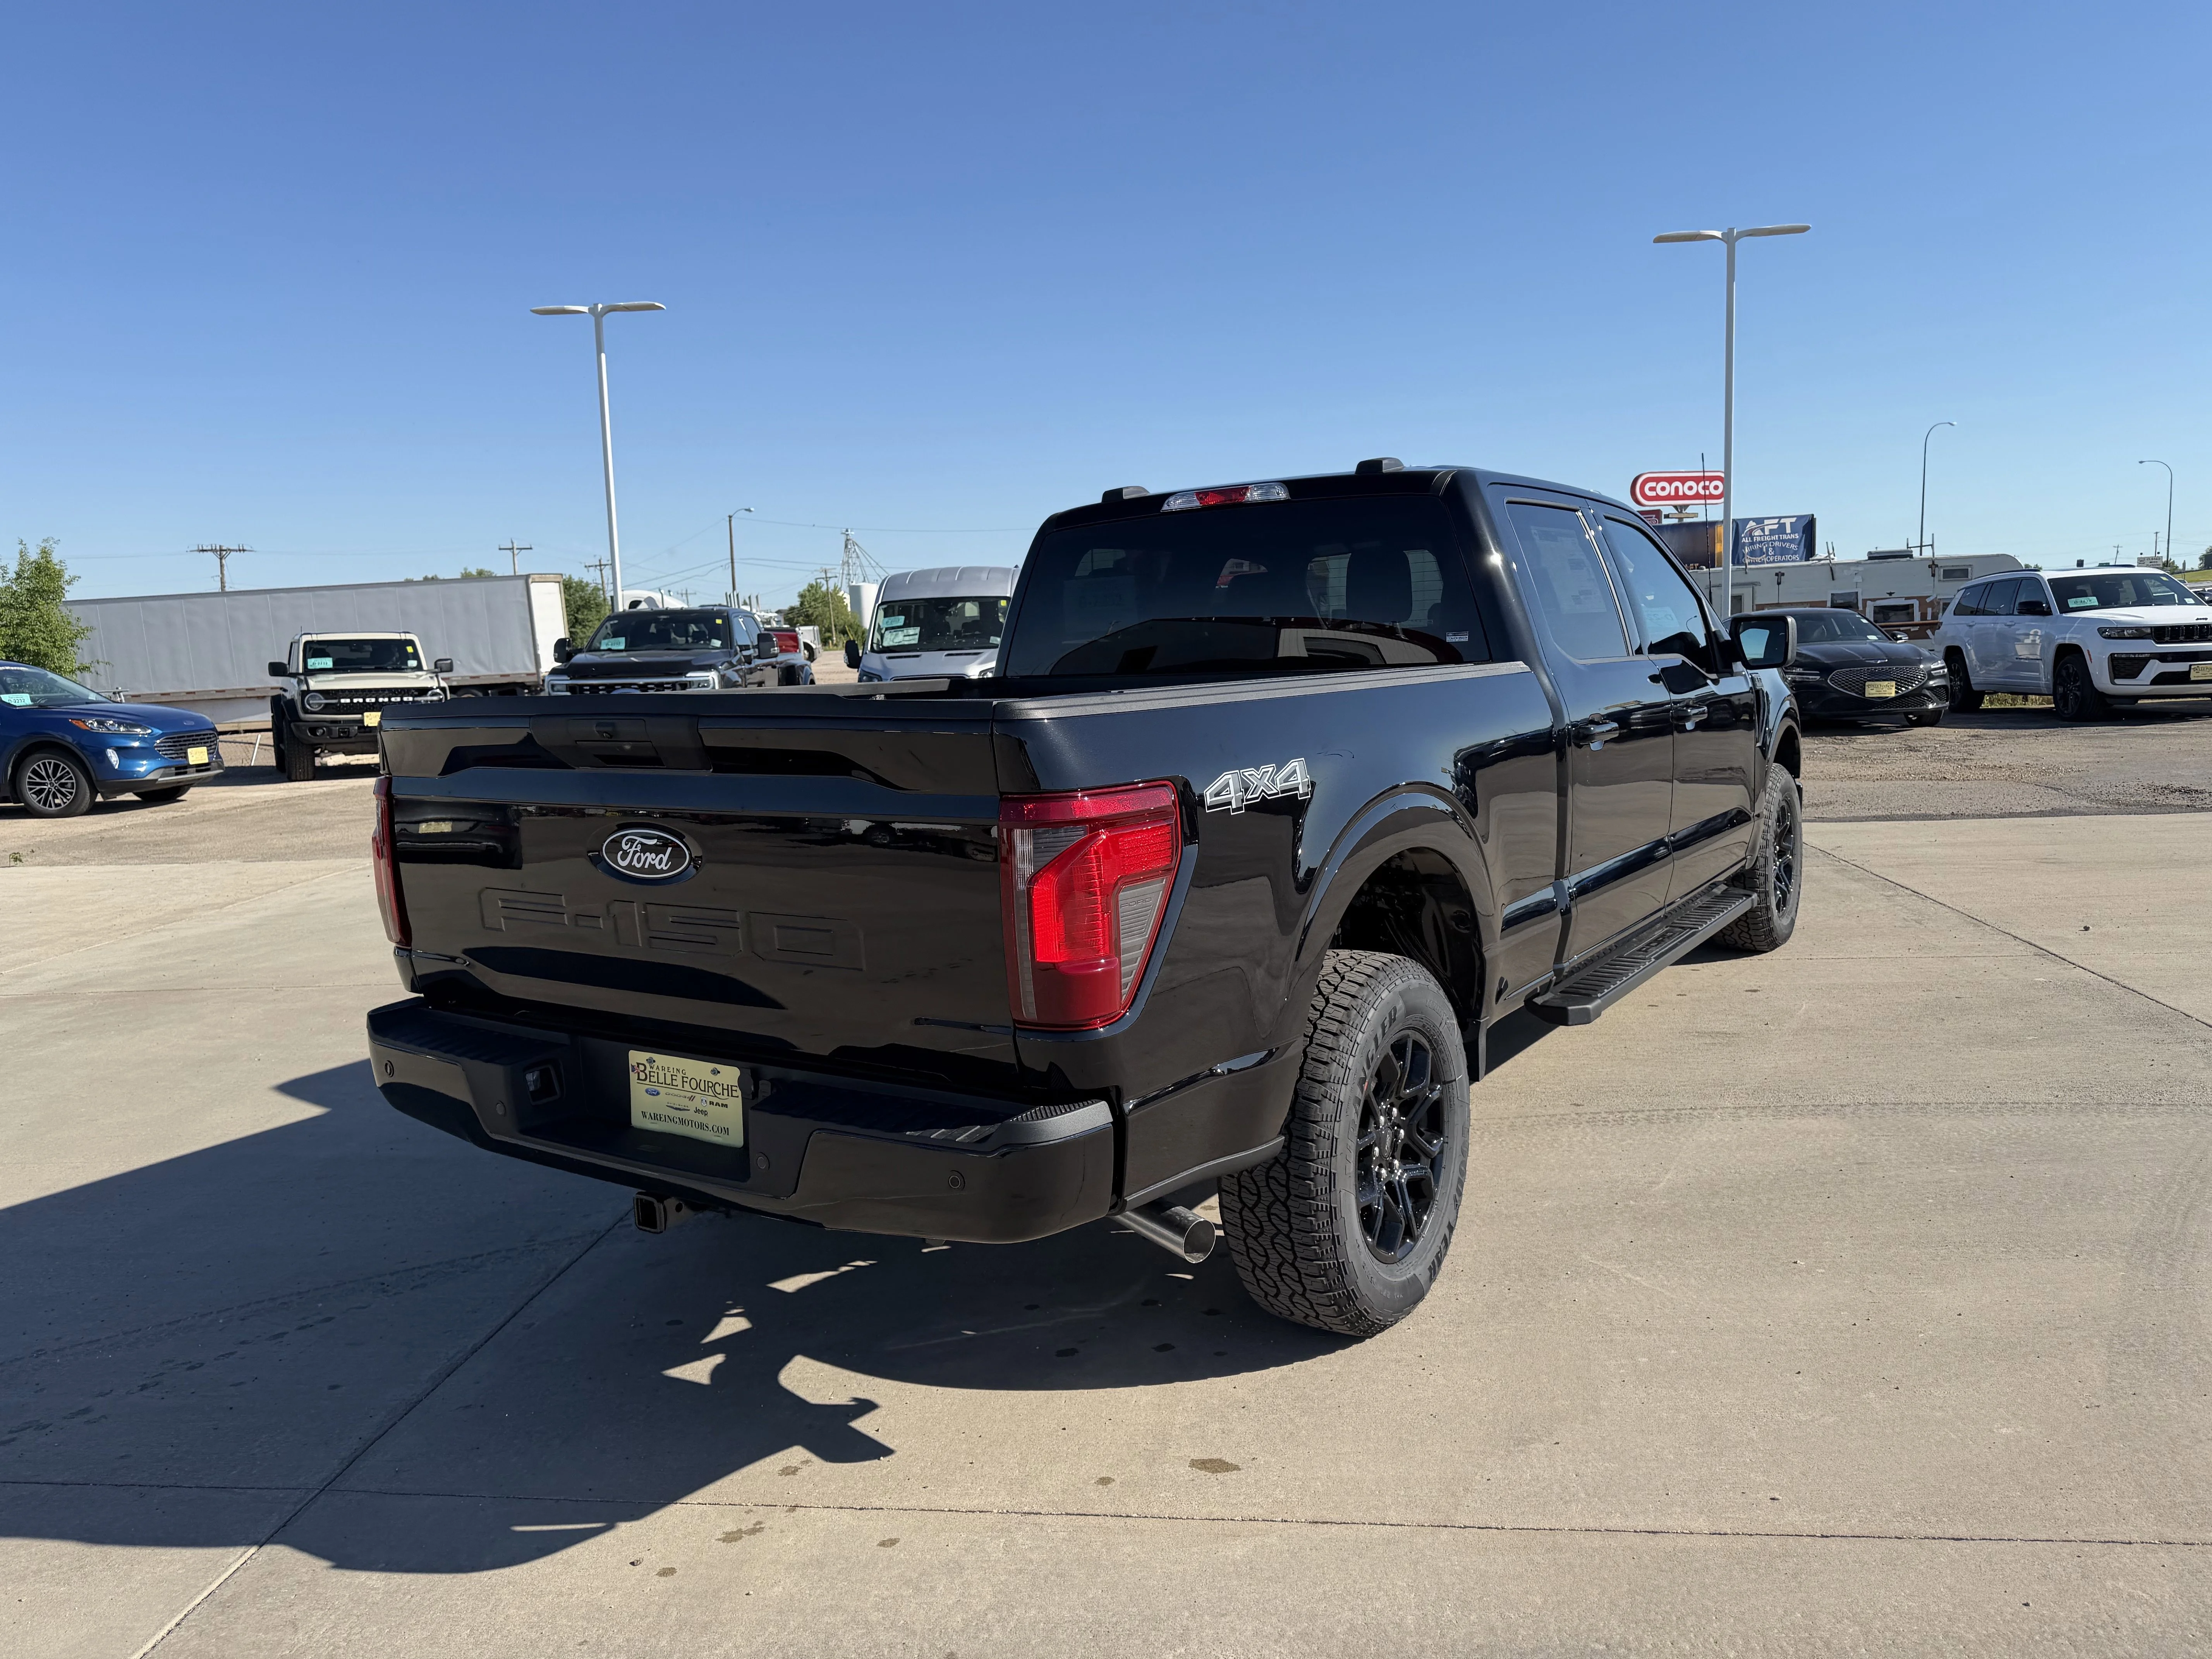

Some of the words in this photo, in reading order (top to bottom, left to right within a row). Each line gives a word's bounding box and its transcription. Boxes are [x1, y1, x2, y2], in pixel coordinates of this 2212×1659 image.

[1741, 517, 1797, 537] AFT
[1769, 541, 1798, 551] DRIVERS
[617, 835, 672, 870] Ford
[1120, 897, 1152, 909] FORD
[649, 1064, 686, 1075] WAREING
[635, 1062, 678, 1087] BELLE
[682, 1075, 739, 1100] FOURCHE
[709, 1100, 728, 1108] RAM
[693, 1106, 708, 1117] Jeep
[641, 1110, 730, 1136] WAREINGMOTORS.COM
